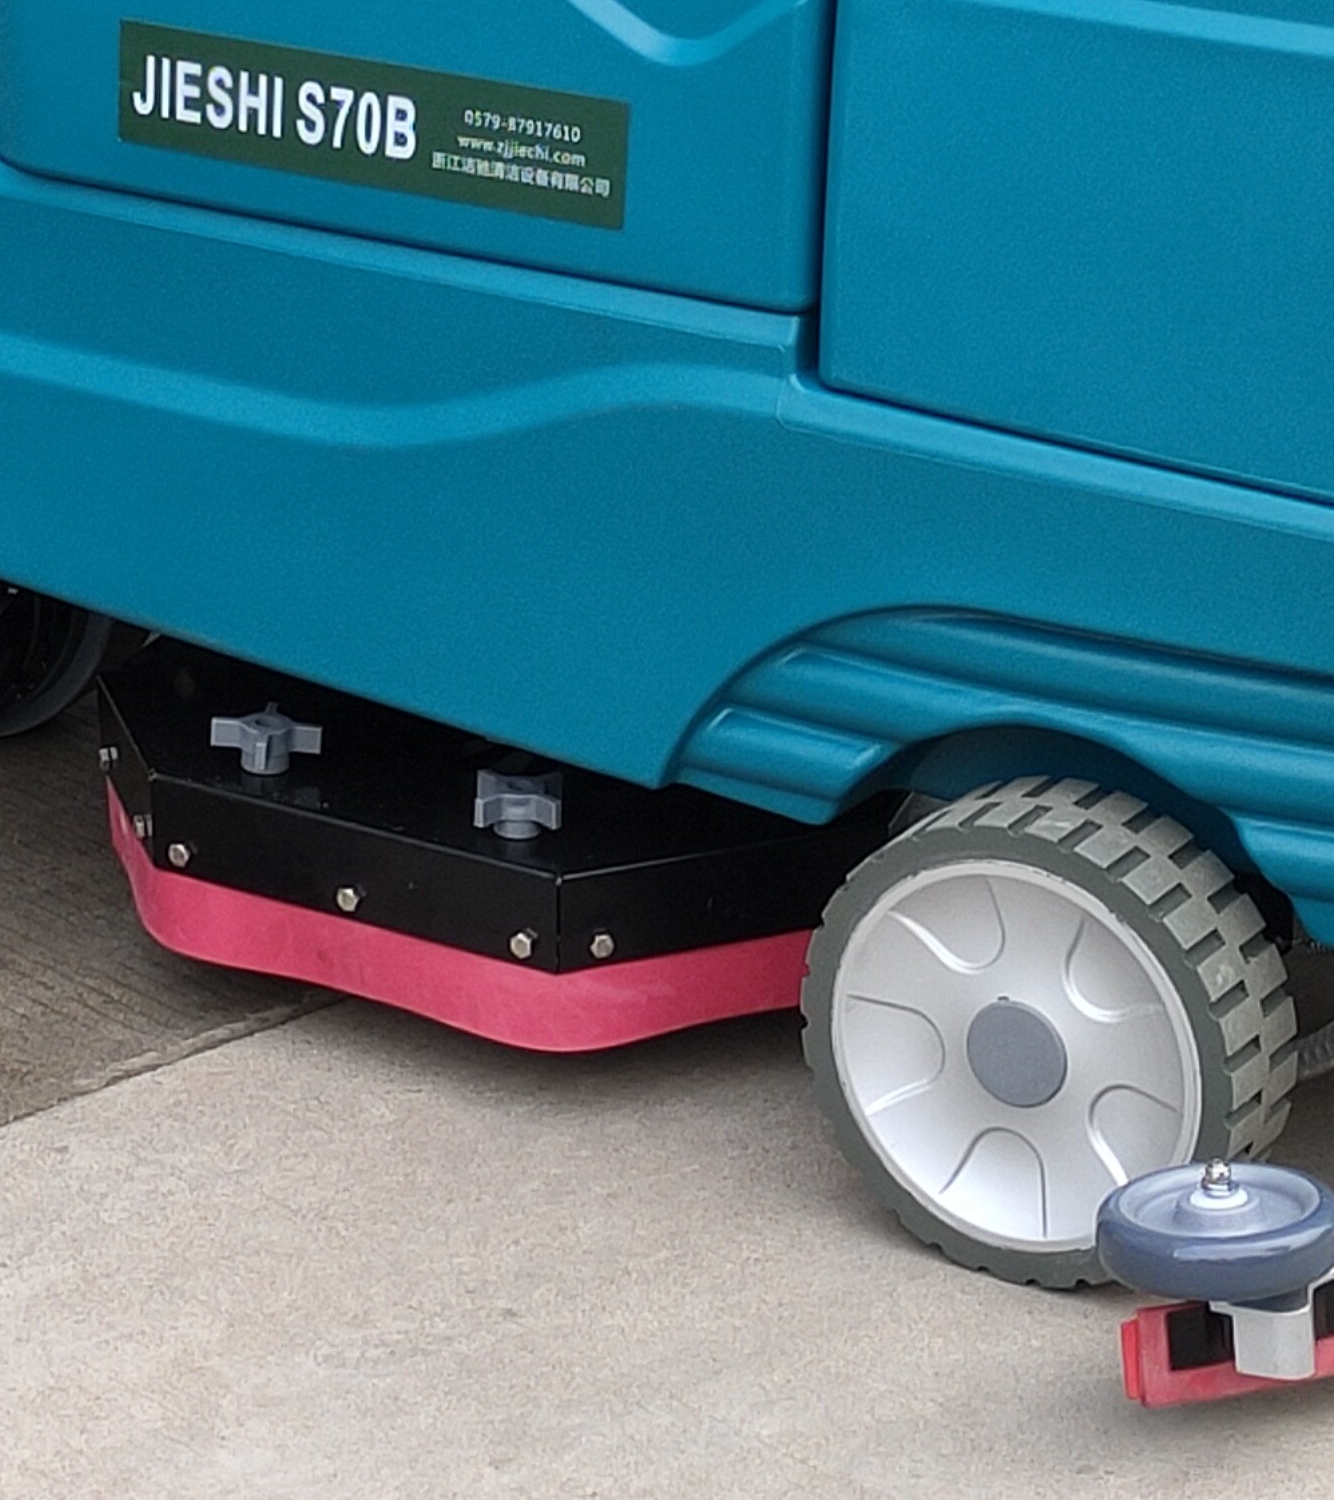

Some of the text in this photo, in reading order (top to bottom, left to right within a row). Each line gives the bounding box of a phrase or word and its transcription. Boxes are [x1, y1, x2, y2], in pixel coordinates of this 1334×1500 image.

[132, 54, 417, 160] JIESHI S70B
[464, 109, 581, 143] 0579-87917610
